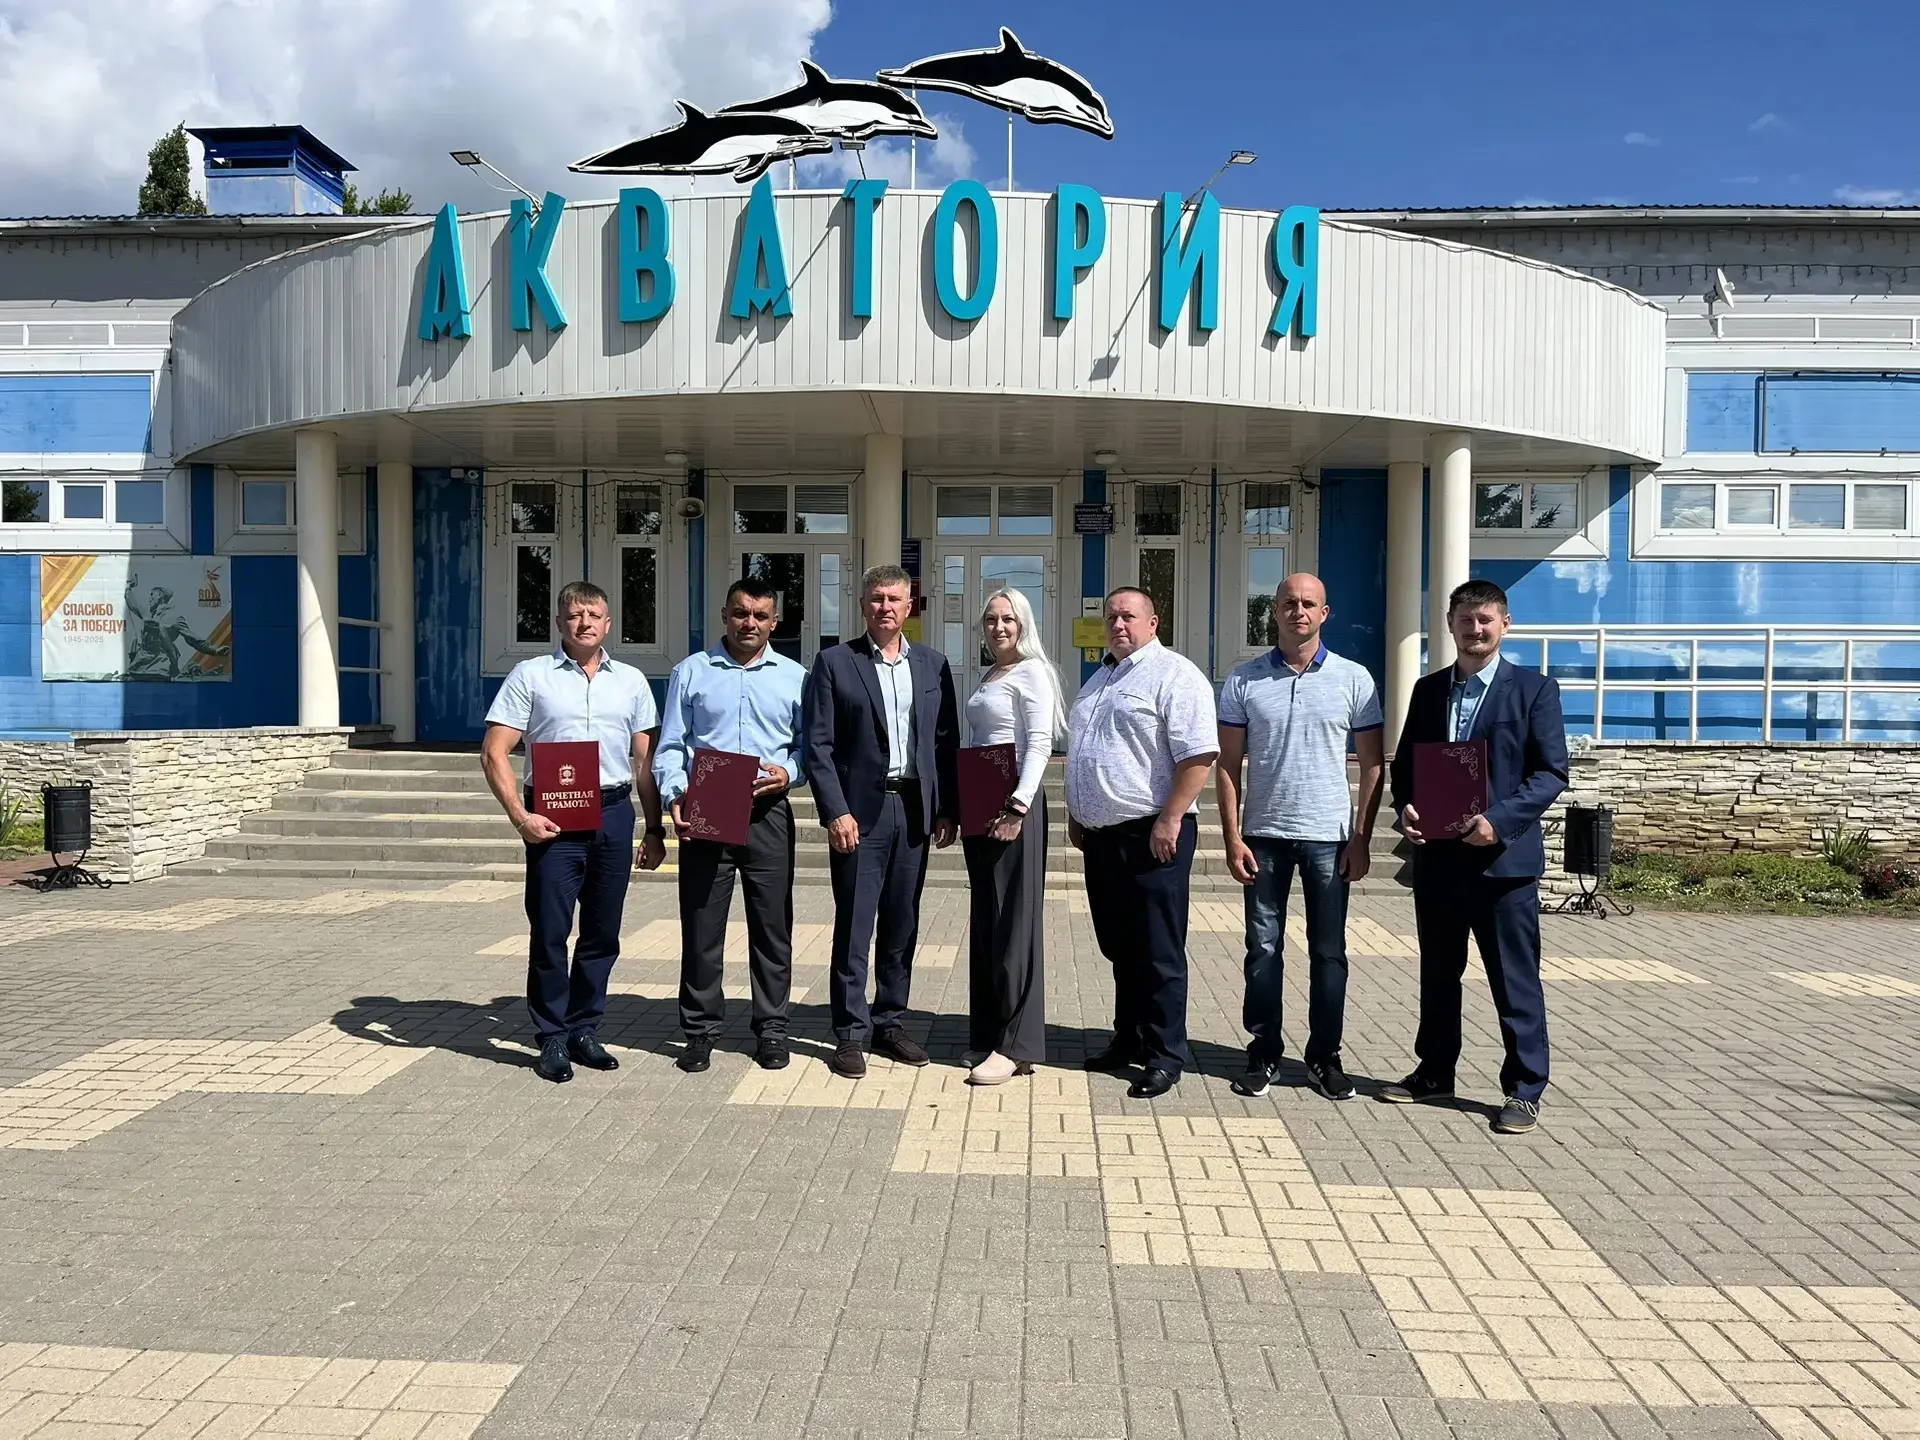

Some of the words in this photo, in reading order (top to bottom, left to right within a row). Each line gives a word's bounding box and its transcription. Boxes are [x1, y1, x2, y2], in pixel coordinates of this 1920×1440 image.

[417, 172, 1320, 342] АКВАТОРИЯ
[63, 603, 113, 616] СПАСИБО
[63, 619, 77, 632] ЗА
[81, 619, 127, 634] ПОБЕДУ!
[64, 635, 104, 643] 1945-2025
[541, 790, 594, 801] ПОЧЕТНАЯ
[546, 799, 590, 809] ГРАМОТА
